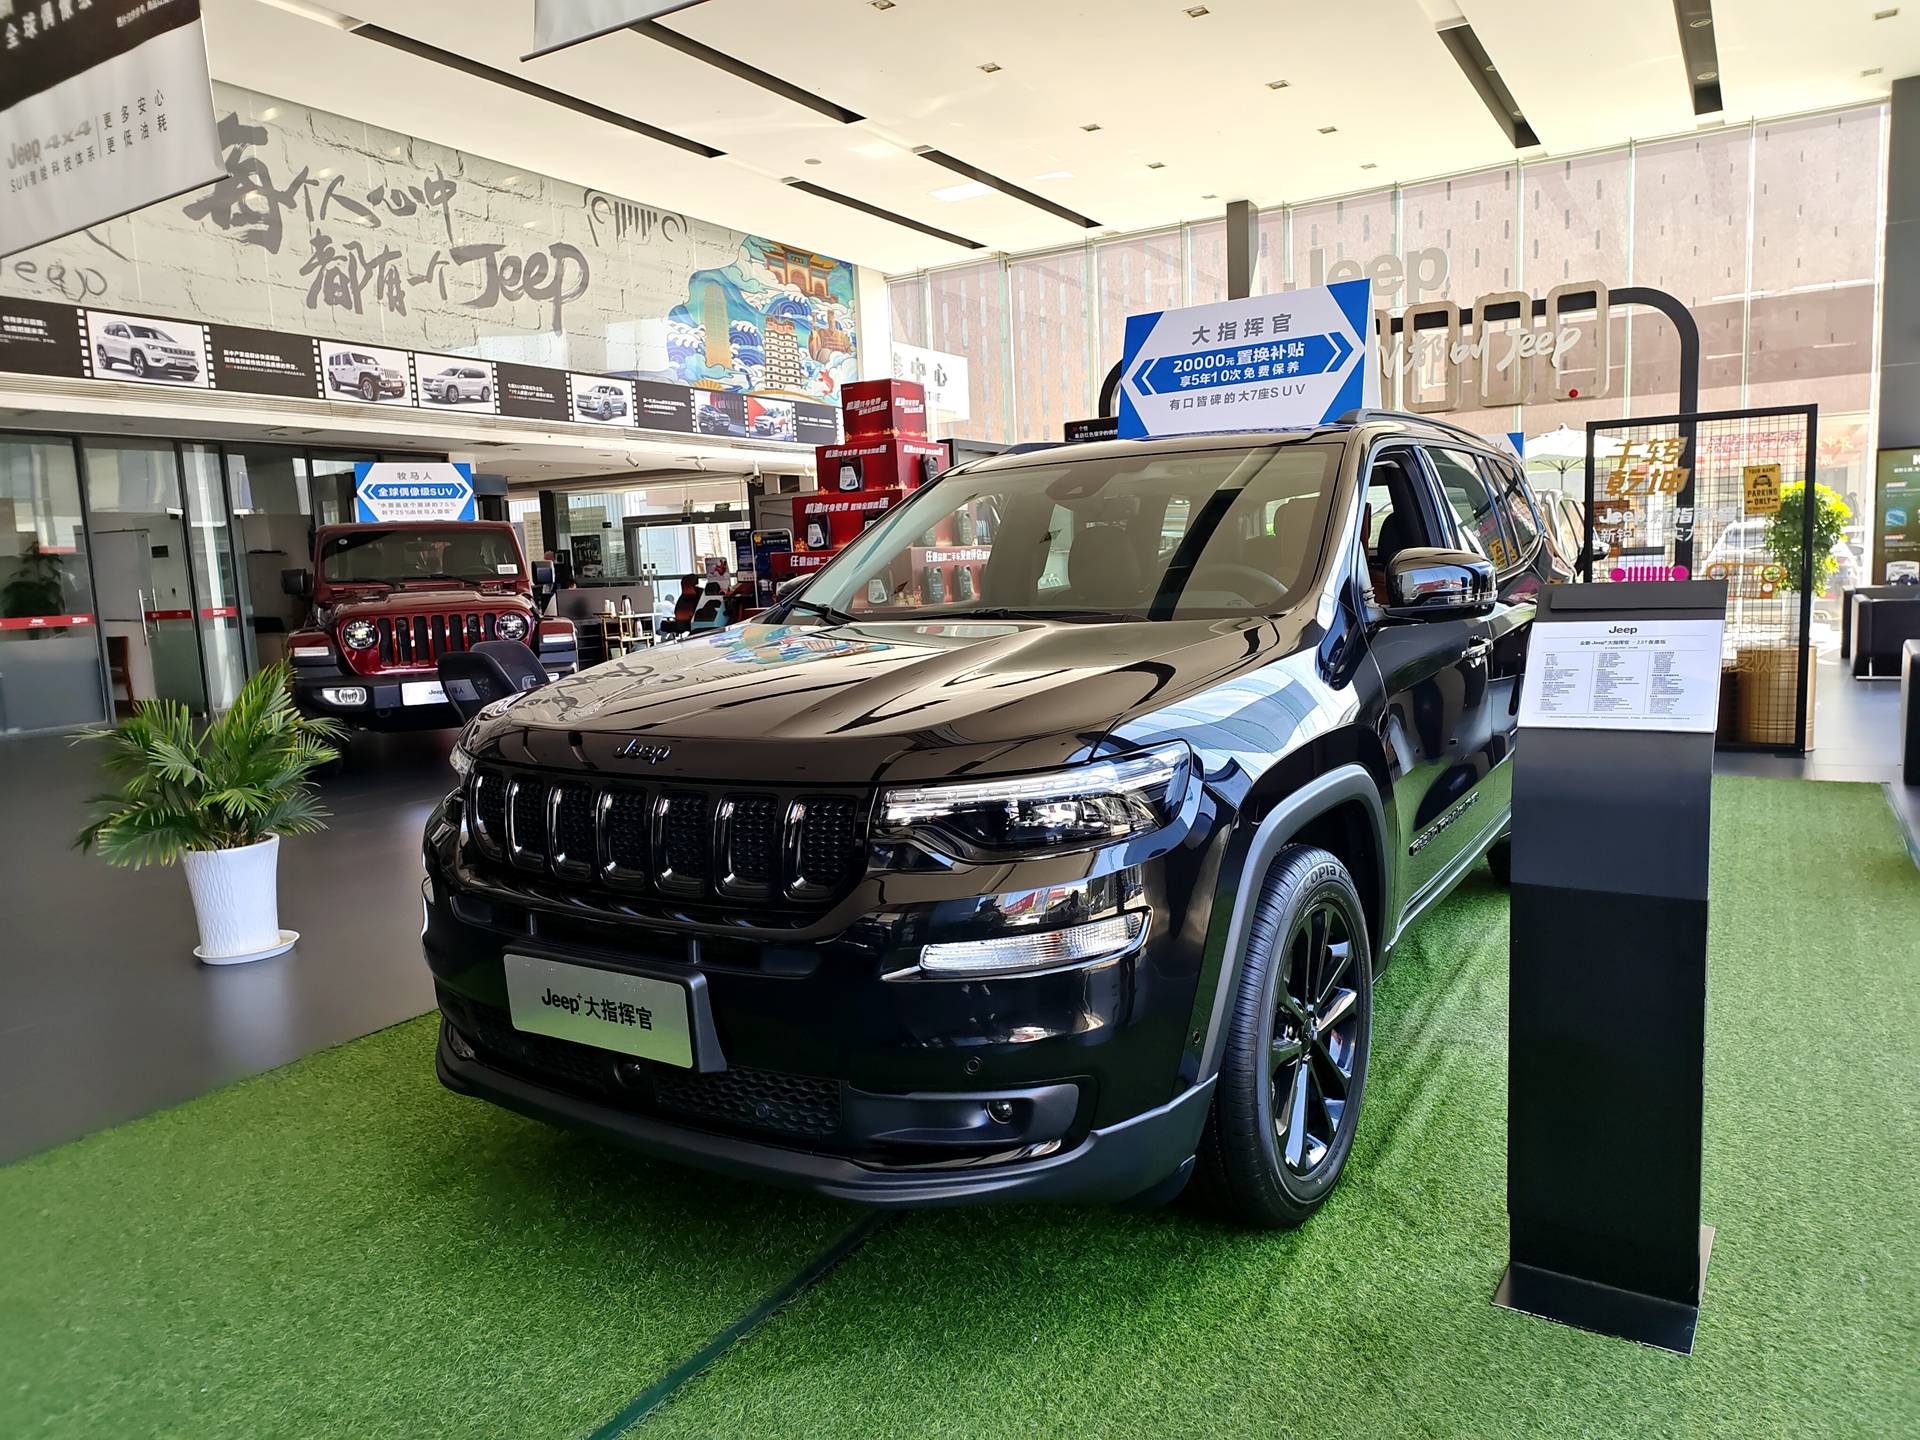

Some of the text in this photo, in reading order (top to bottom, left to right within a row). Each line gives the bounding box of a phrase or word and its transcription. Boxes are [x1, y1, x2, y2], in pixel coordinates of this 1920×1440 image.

[102, 89, 164, 130] 更多安心
[105, 113, 167, 155] 更低油耗
[7, 138, 43, 170] Jeep
[1191, 313, 1292, 346] 大指挥官
[1179, 361, 1300, 388] 享5年10次免费保养
[1169, 383, 1306, 411] 有口皆碑的大7座SUV
[396, 471, 433, 481] 牧马人
[378, 486, 454, 498] 全球偶像级SUV
[1747, 488, 1778, 498] PARKING
[1754, 497, 1771, 505] ONLY
[1608, 626, 1638, 635] Jeep
[613, 738, 672, 767] Jeep
[584, 996, 653, 1031] 大指挥官
